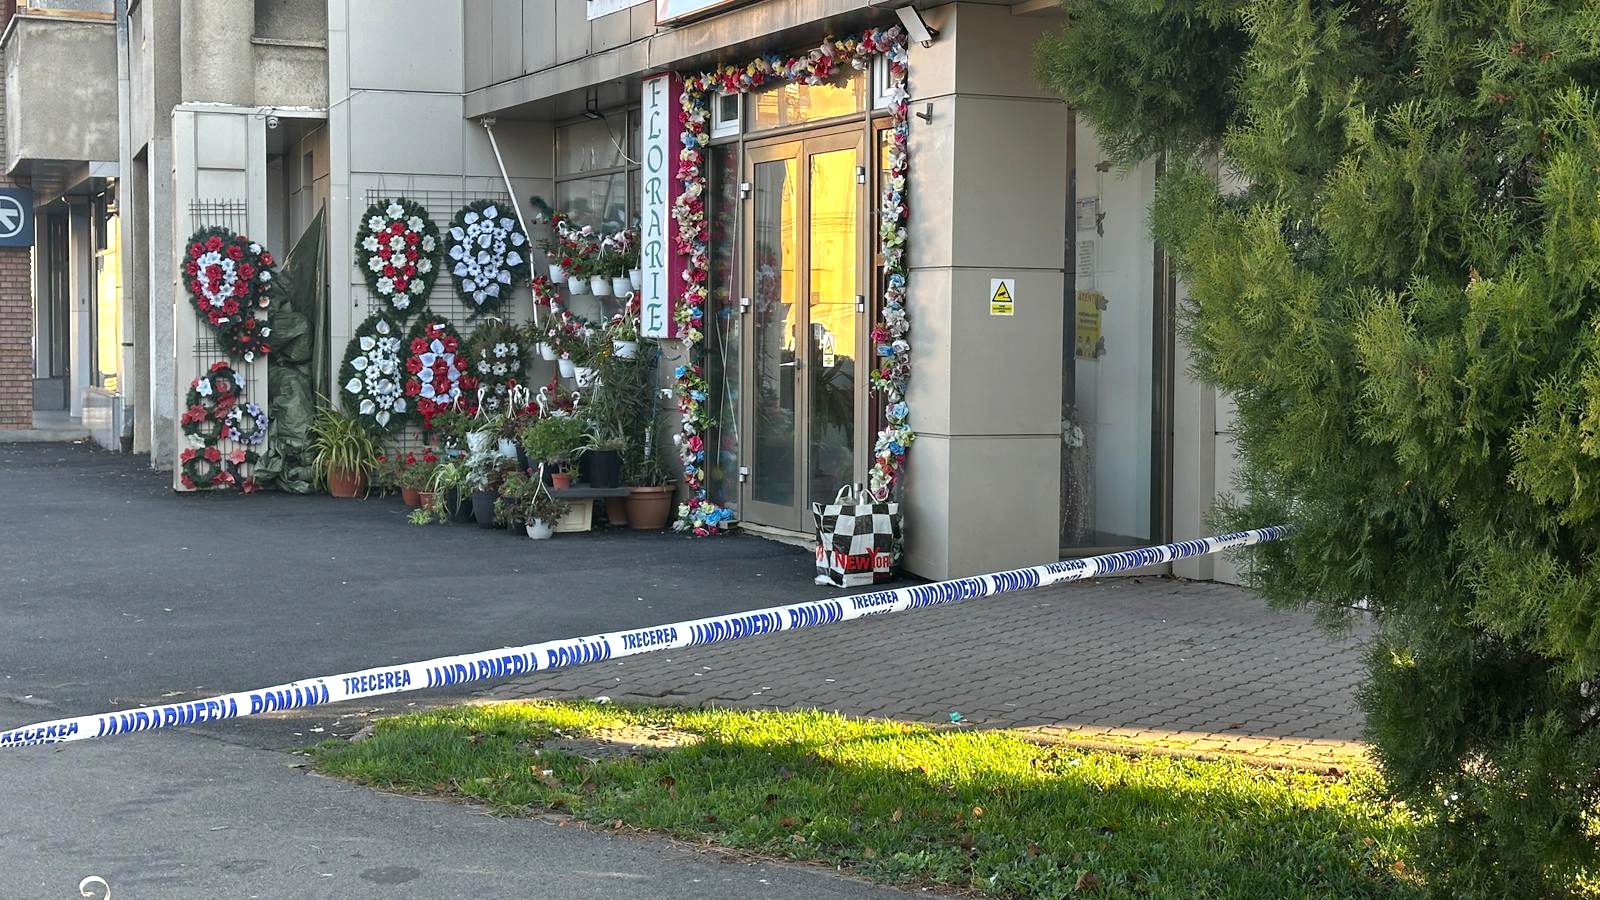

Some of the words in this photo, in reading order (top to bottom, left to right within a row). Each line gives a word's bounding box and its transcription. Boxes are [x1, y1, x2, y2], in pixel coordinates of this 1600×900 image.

[645, 79, 664, 331] FLORARIE
[343, 669, 411, 695] TRECEREA
[621, 627, 678, 650] TRECEREA
[687, 611, 783, 646] JANDARMERIA
[850, 590, 899, 610] TRECEREA
[905, 577, 988, 610] JANDARMERIA
